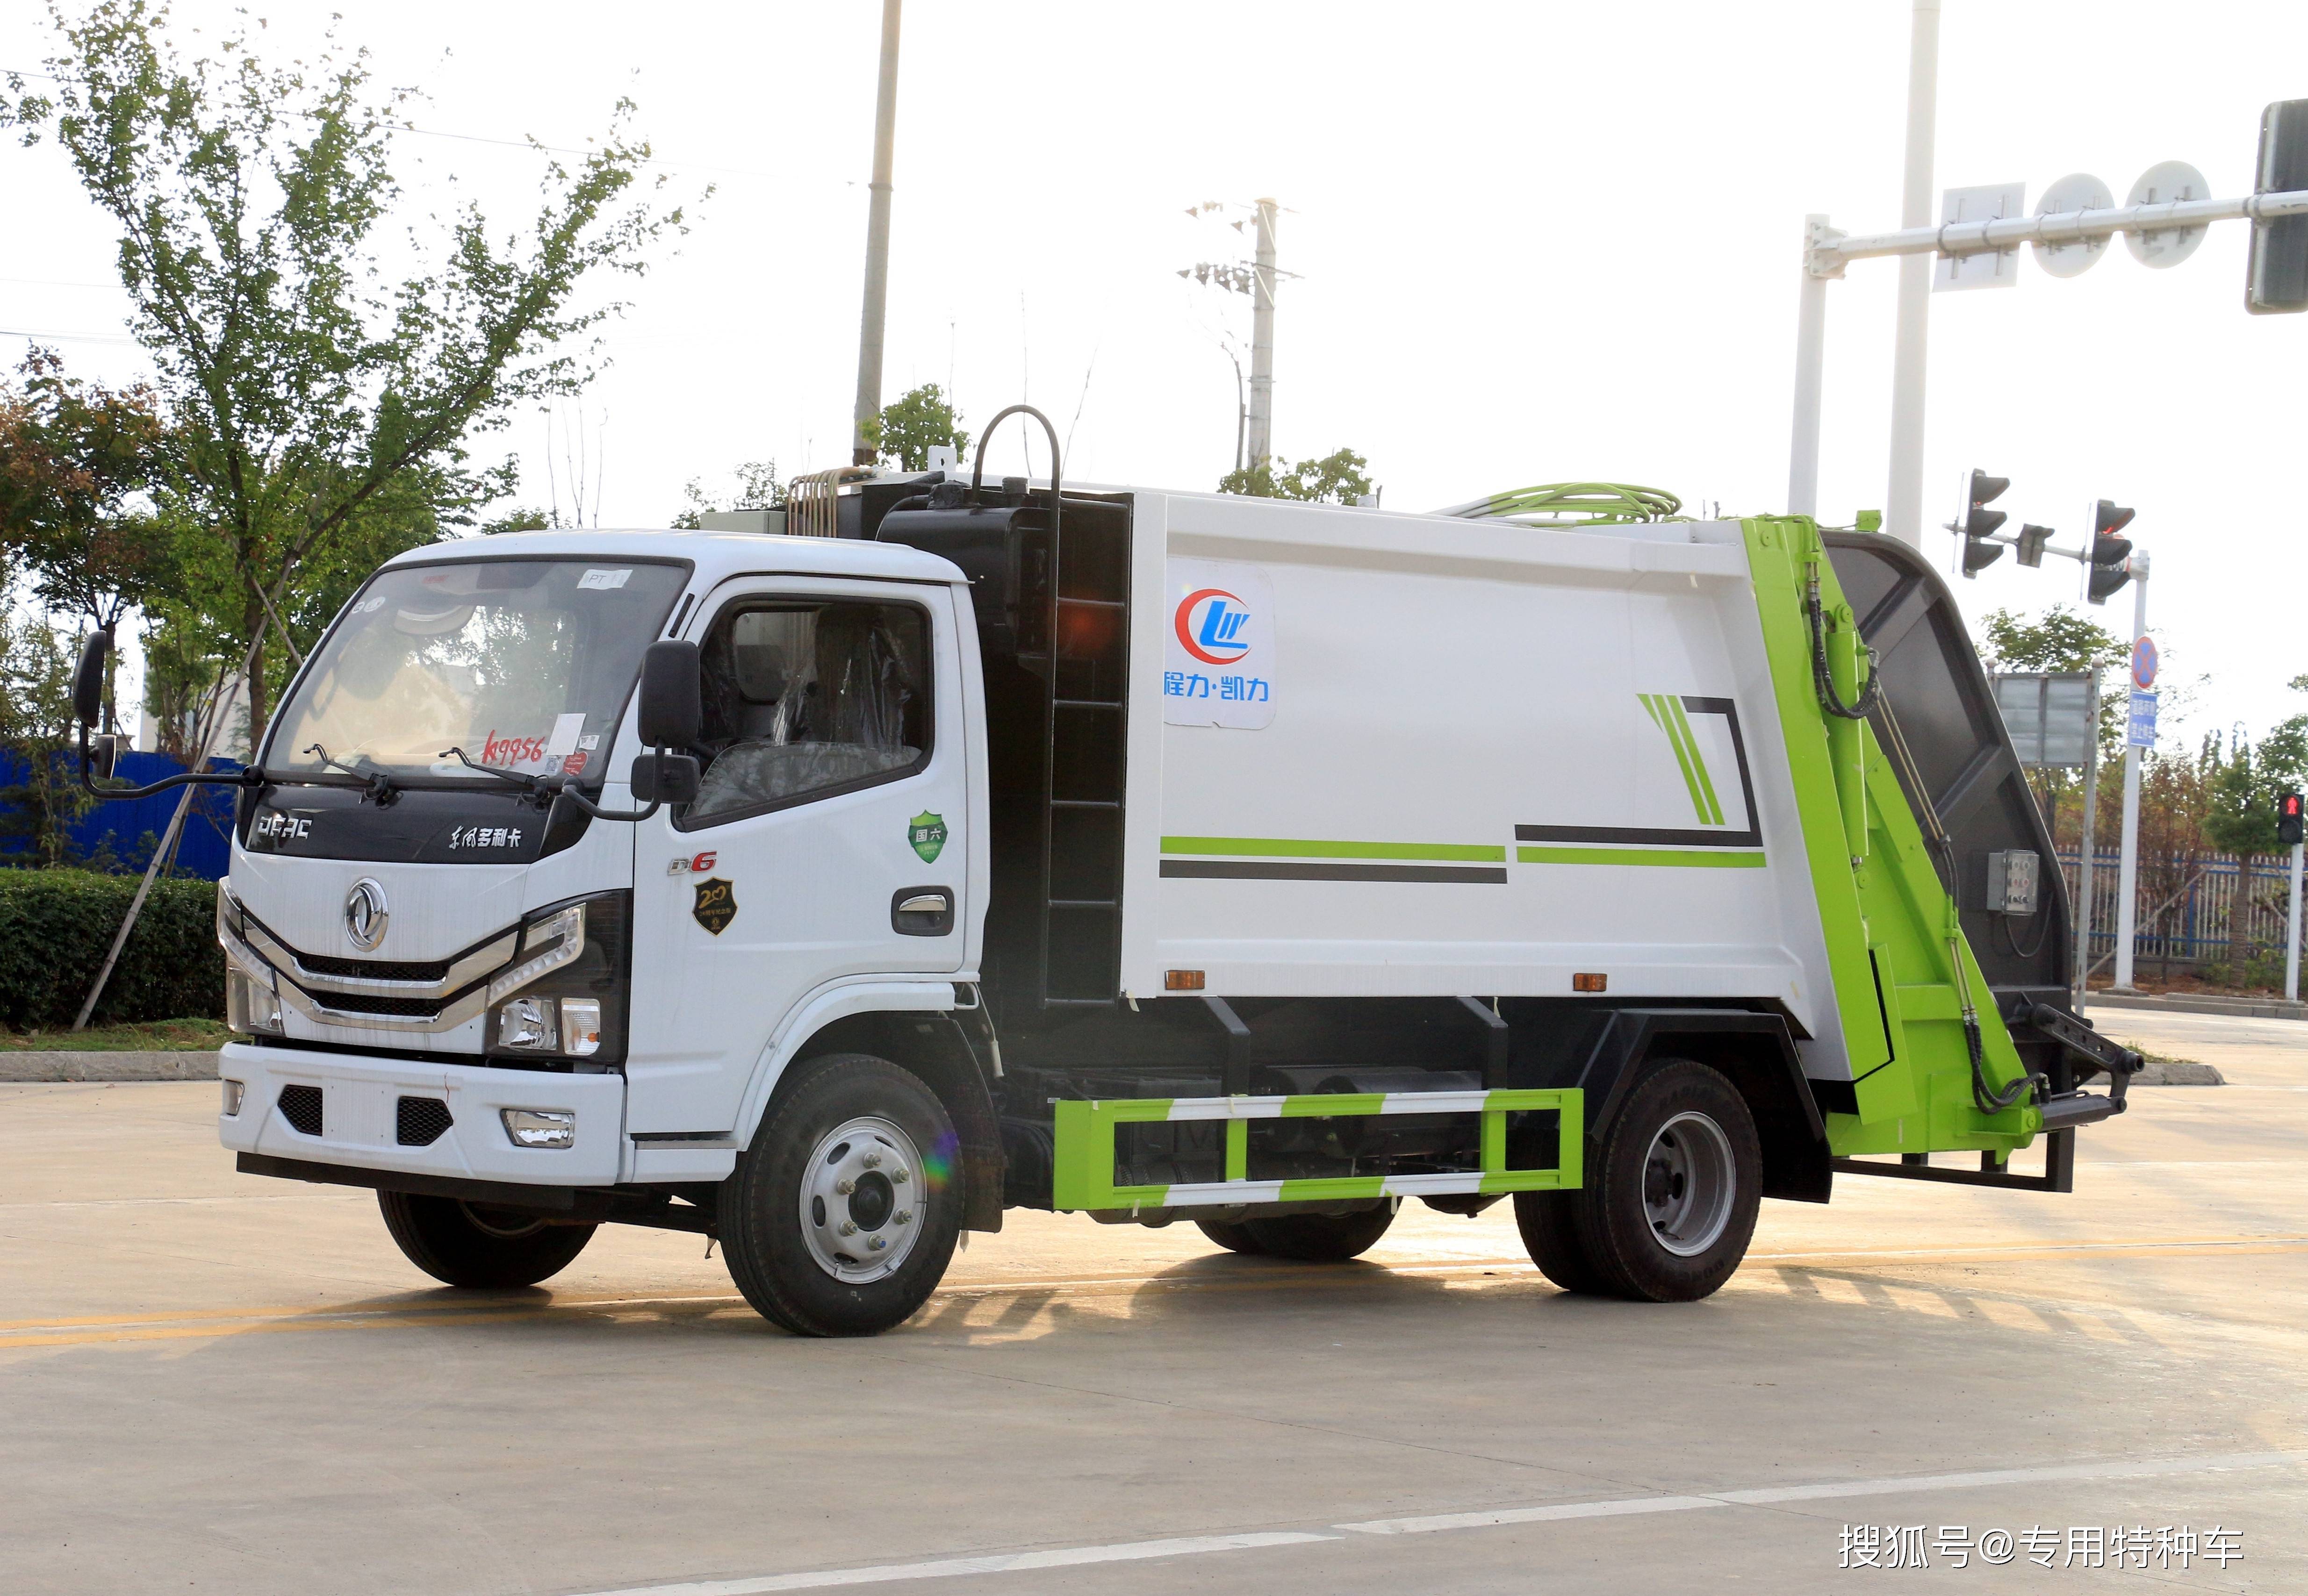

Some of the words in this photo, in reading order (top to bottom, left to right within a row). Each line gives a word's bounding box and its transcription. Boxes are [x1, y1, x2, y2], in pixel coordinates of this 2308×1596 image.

[588, 574, 607, 584] PT
[449, 825, 521, 850] 东风多利卡
[916, 828, 941, 842] 国六
